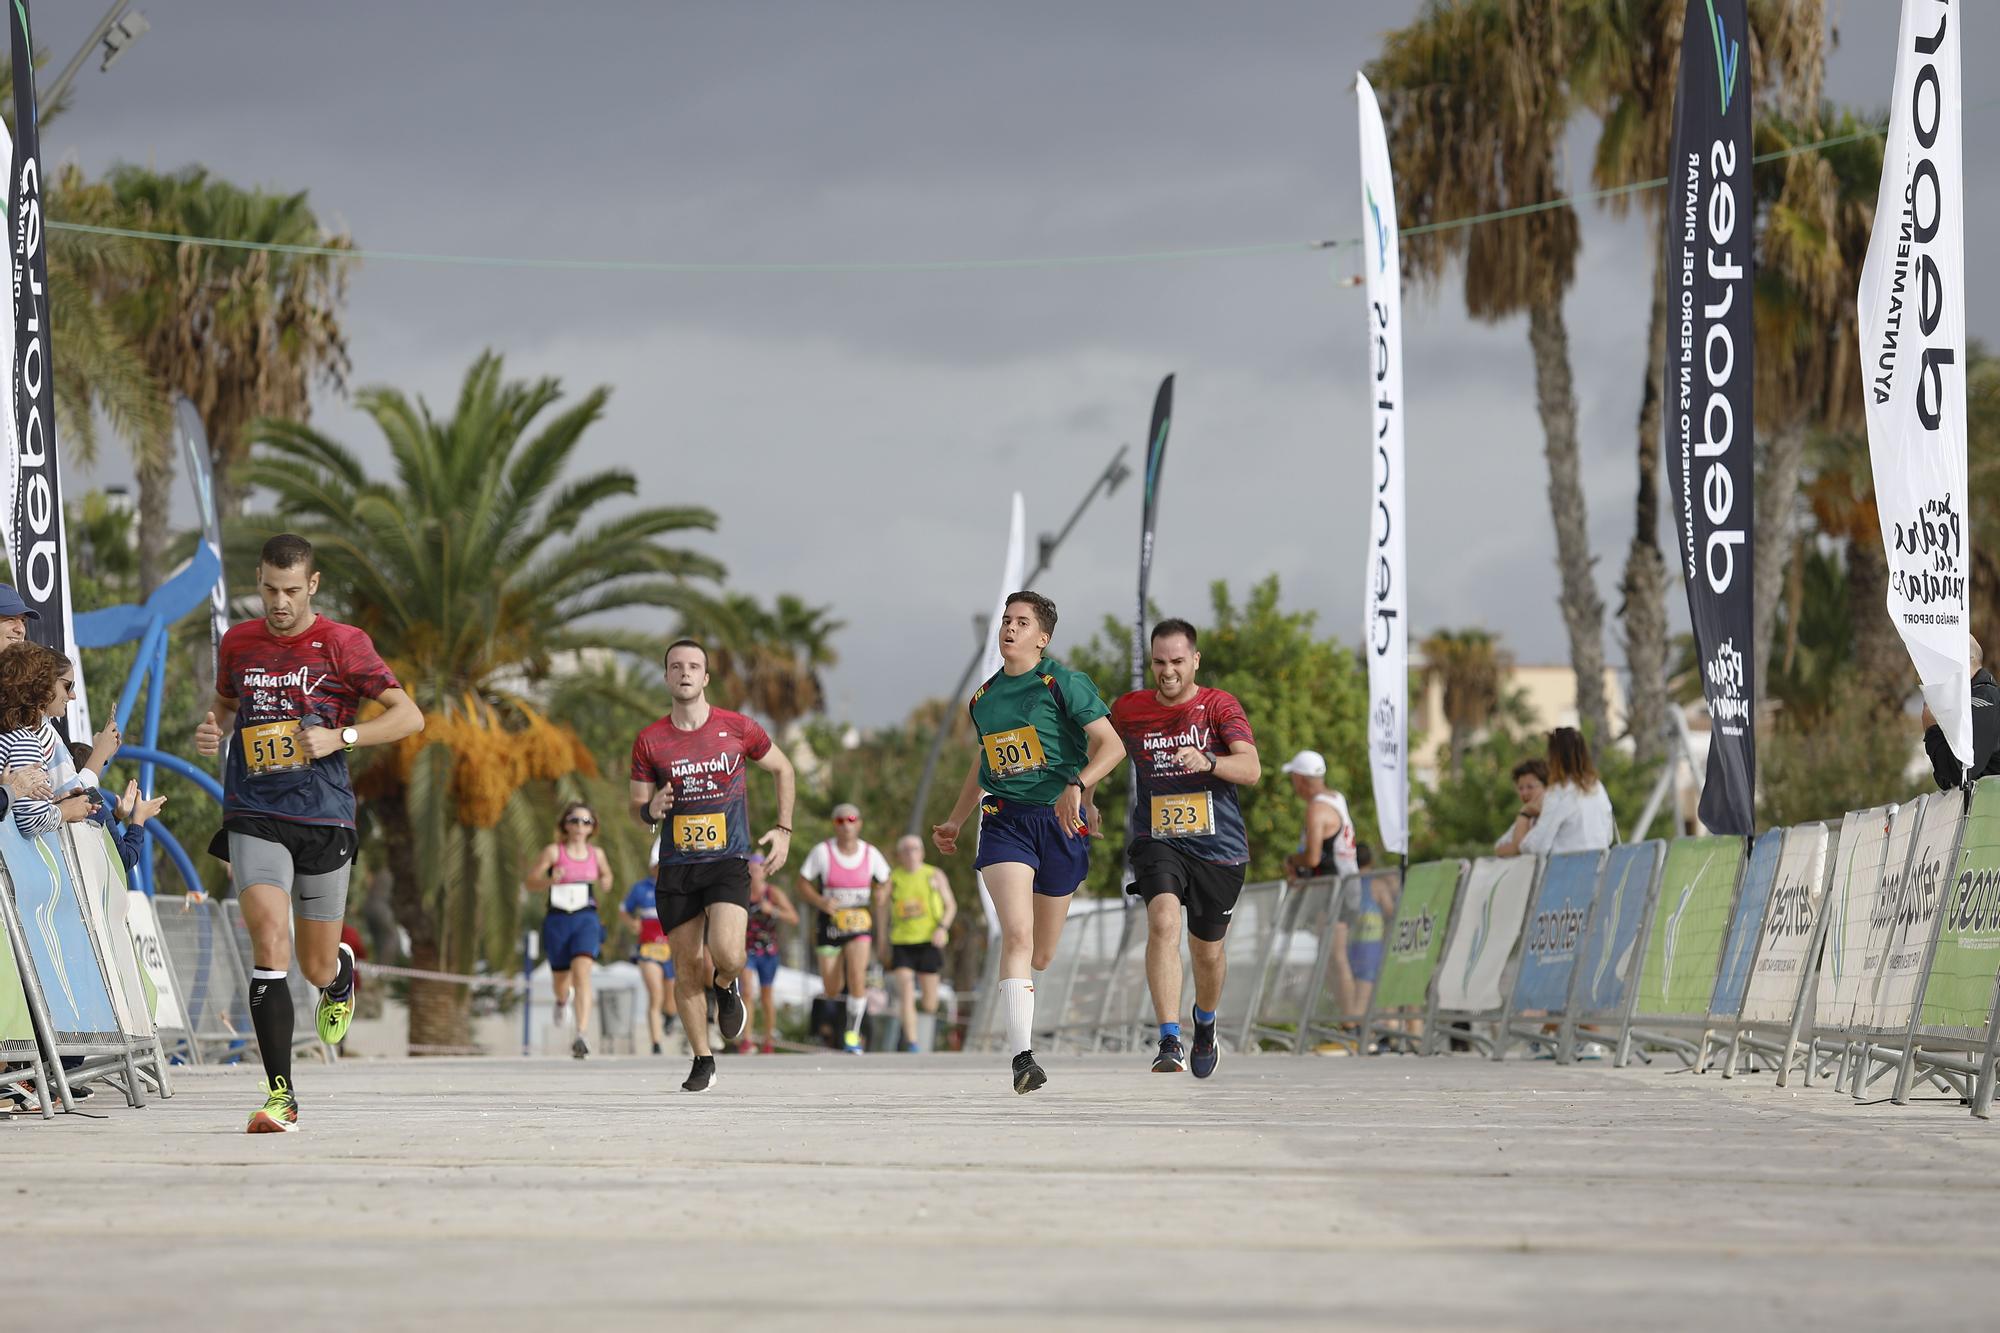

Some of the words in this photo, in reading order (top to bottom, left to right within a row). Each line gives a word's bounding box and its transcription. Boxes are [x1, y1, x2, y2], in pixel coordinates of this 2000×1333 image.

[243, 671, 302, 688] MARATÓN
[252, 736, 296, 763] 513
[1143, 731, 1195, 750] MARATÓN
[994, 740, 1033, 767] 301
[671, 758, 725, 778] MARATÓN
[1160, 806, 1198, 827] 323
[682, 824, 717, 842] 326
